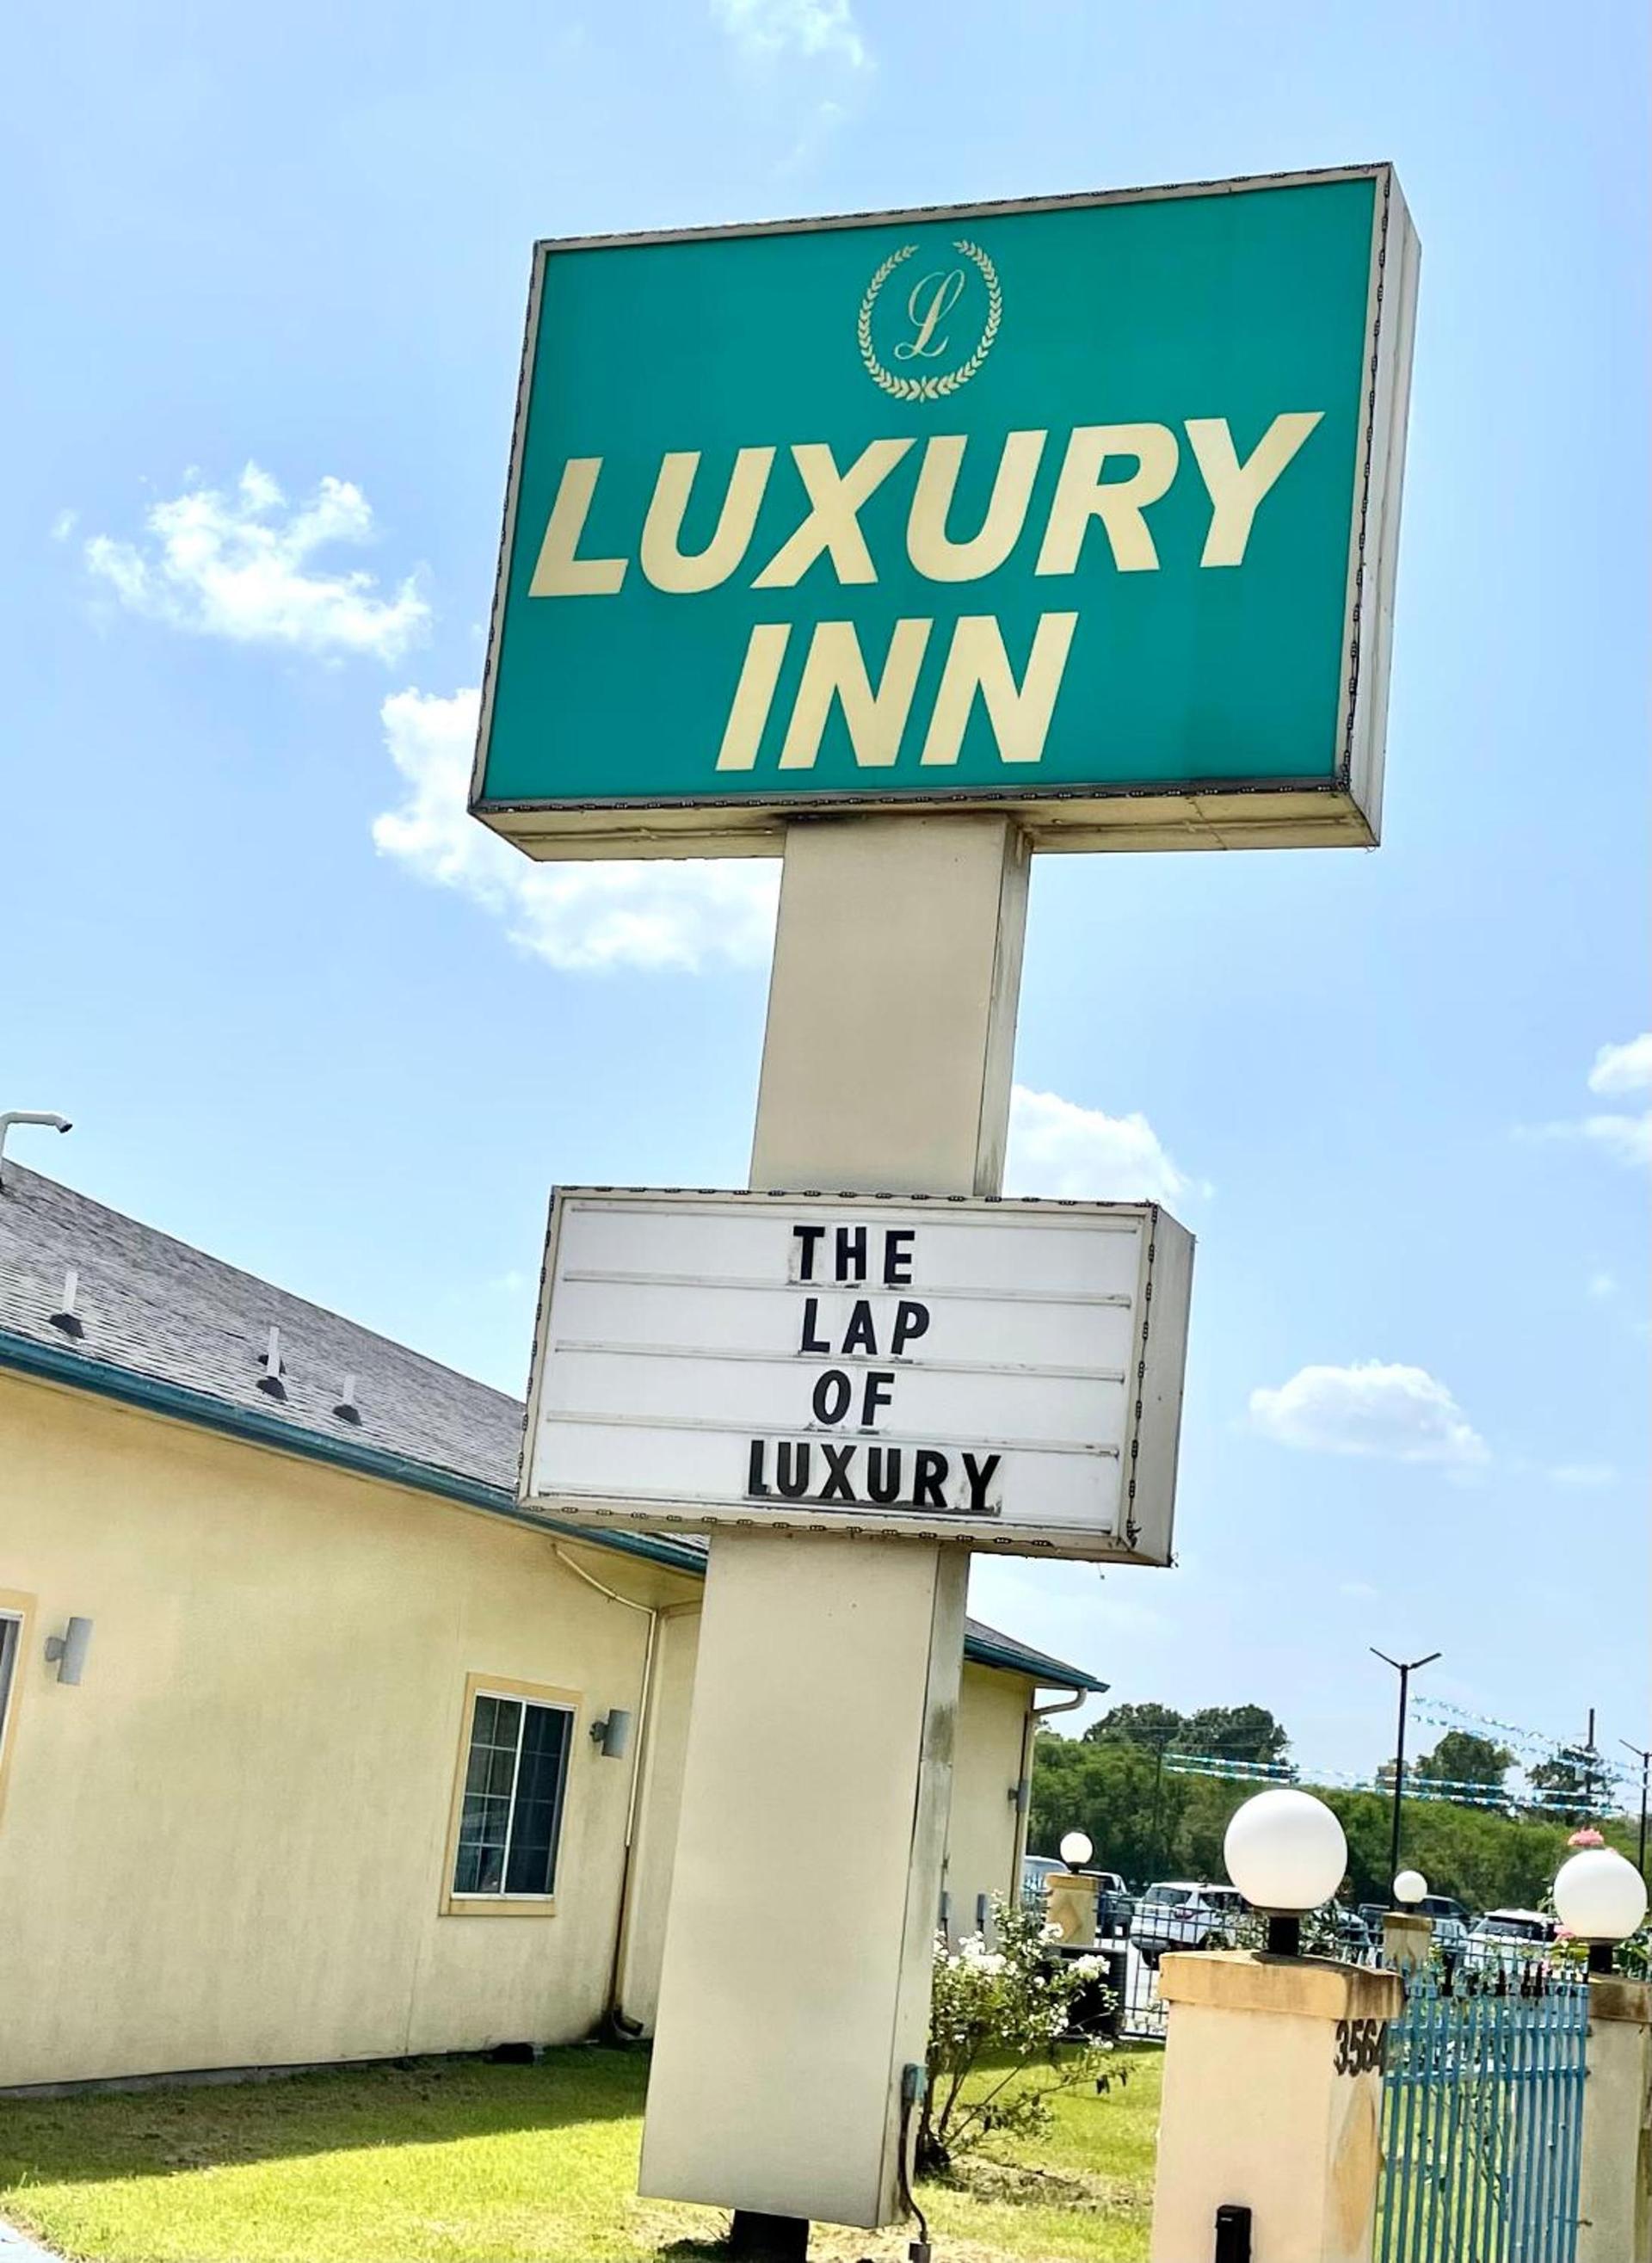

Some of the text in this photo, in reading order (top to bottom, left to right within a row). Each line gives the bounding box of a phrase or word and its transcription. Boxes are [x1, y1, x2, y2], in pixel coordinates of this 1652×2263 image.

[529, 411, 1325, 599] LUXURY
[716, 612, 1079, 771] INN
[793, 1226, 915, 1284] THE
[801, 1298, 930, 1355] LAP
[812, 1370, 895, 1426] OF
[749, 1440, 1002, 1510] LUXURY
